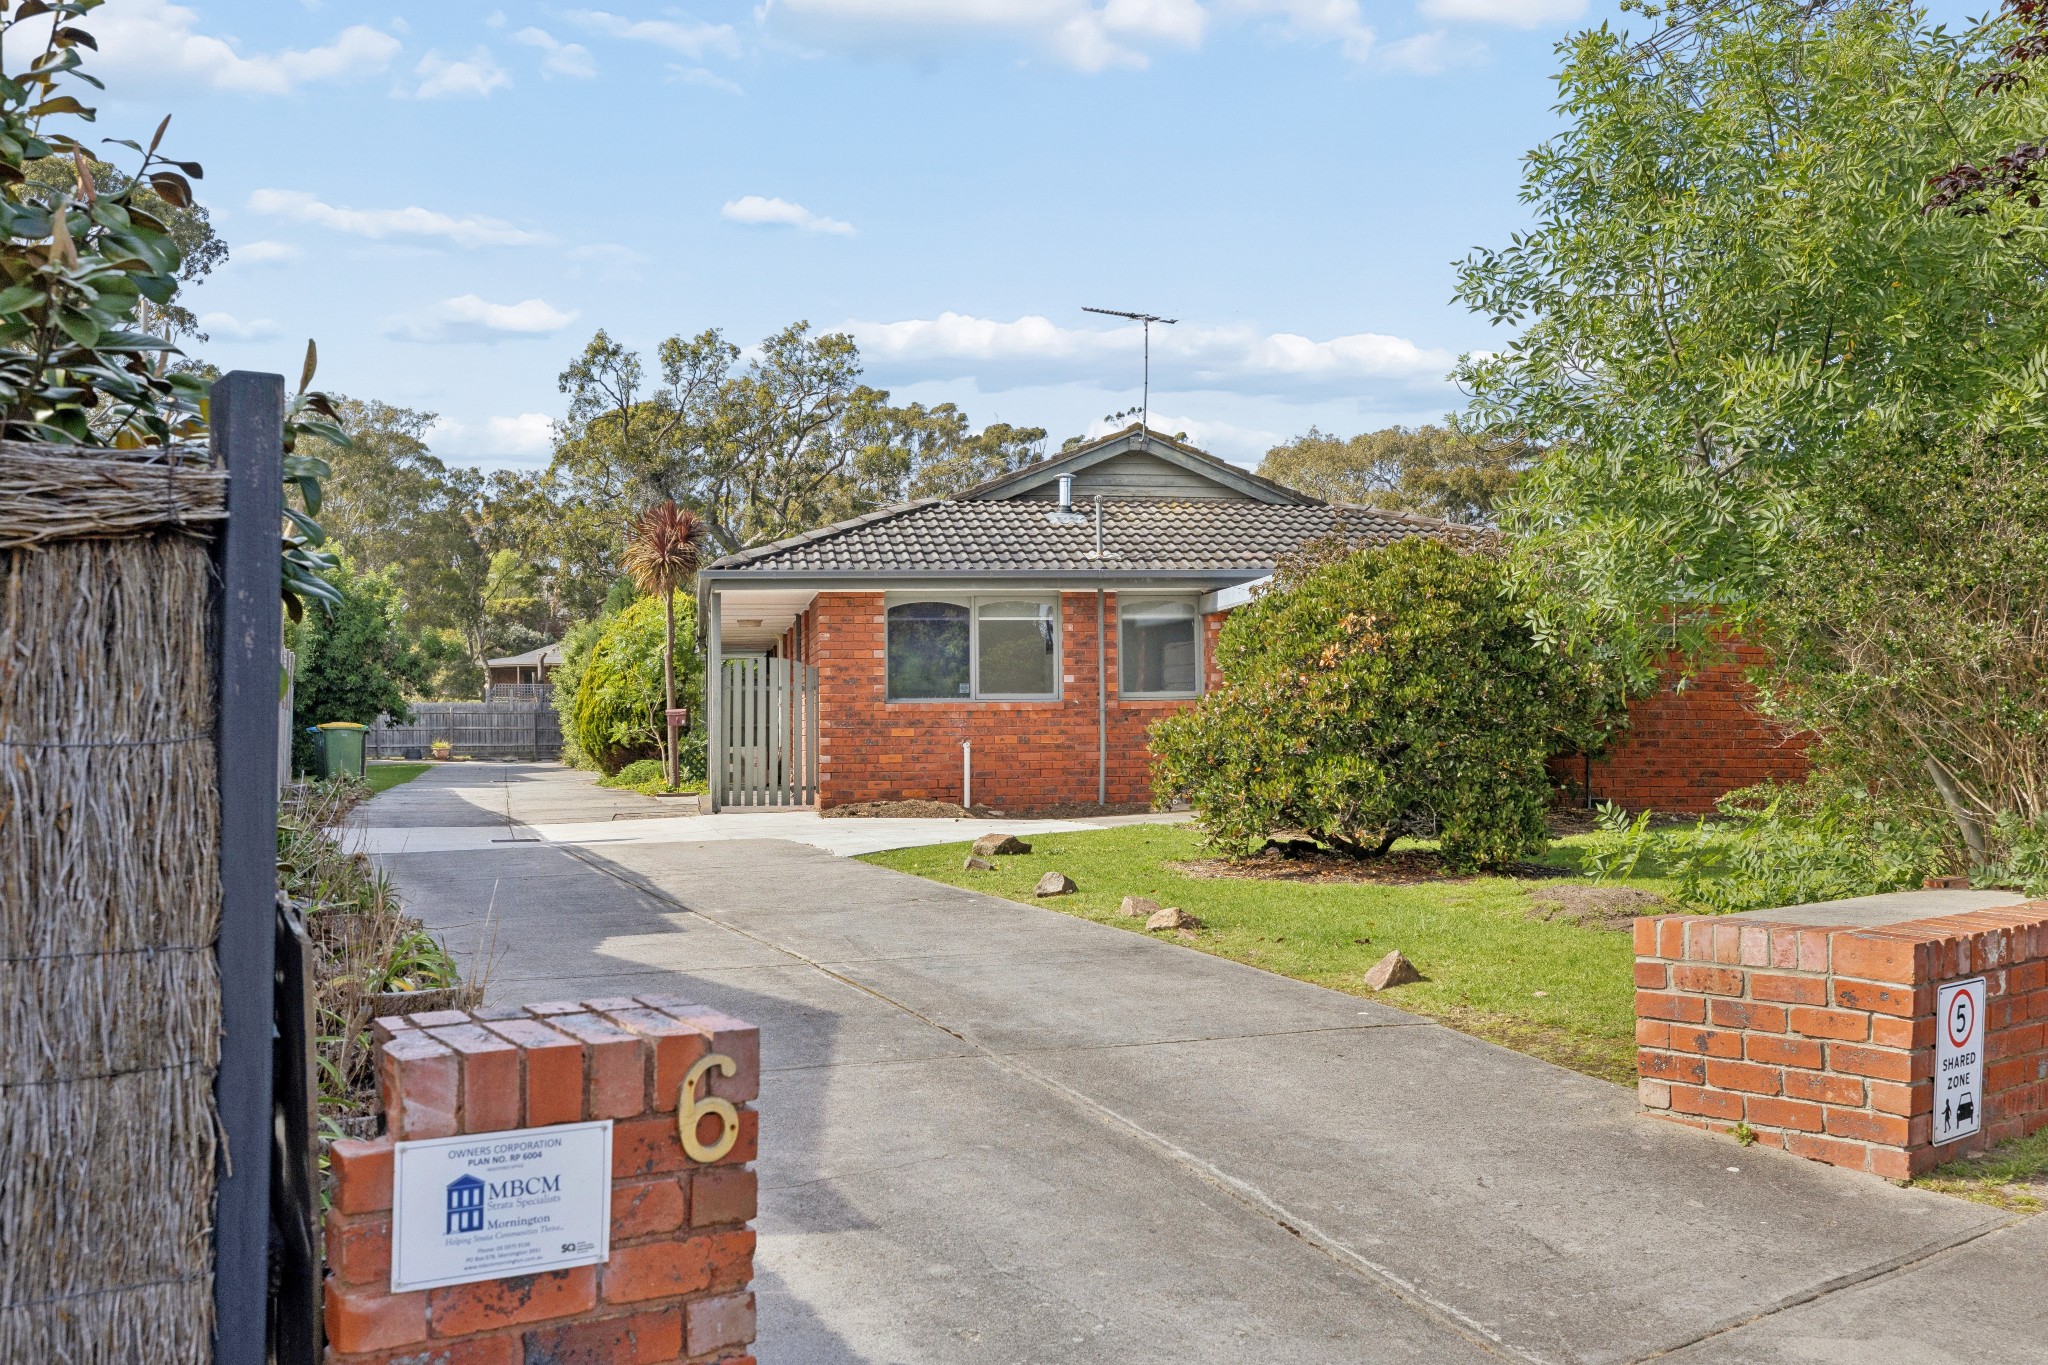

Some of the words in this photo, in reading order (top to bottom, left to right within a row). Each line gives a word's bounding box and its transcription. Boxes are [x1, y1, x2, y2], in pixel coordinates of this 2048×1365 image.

[1956, 1004, 1966, 1033] 5
[1943, 1052, 1976, 1072] SHARED
[1947, 1072, 1970, 1090] ZONE
[678, 1054, 739, 1163] 6
[448, 1146, 491, 1160] OWNERS
[493, 1138, 562, 1154] CORPORATION
[468, 1157, 490, 1167] PLAN
[492, 1155, 508, 1164] NO.
[510, 1153, 521, 1162] RP
[523, 1151, 543, 1160] 6004
[489, 1174, 561, 1200] MBCM
[487, 1201, 513, 1211] Strata
[516, 1195, 561, 1208] Specialists
[488, 1215, 550, 1230] Mornington
